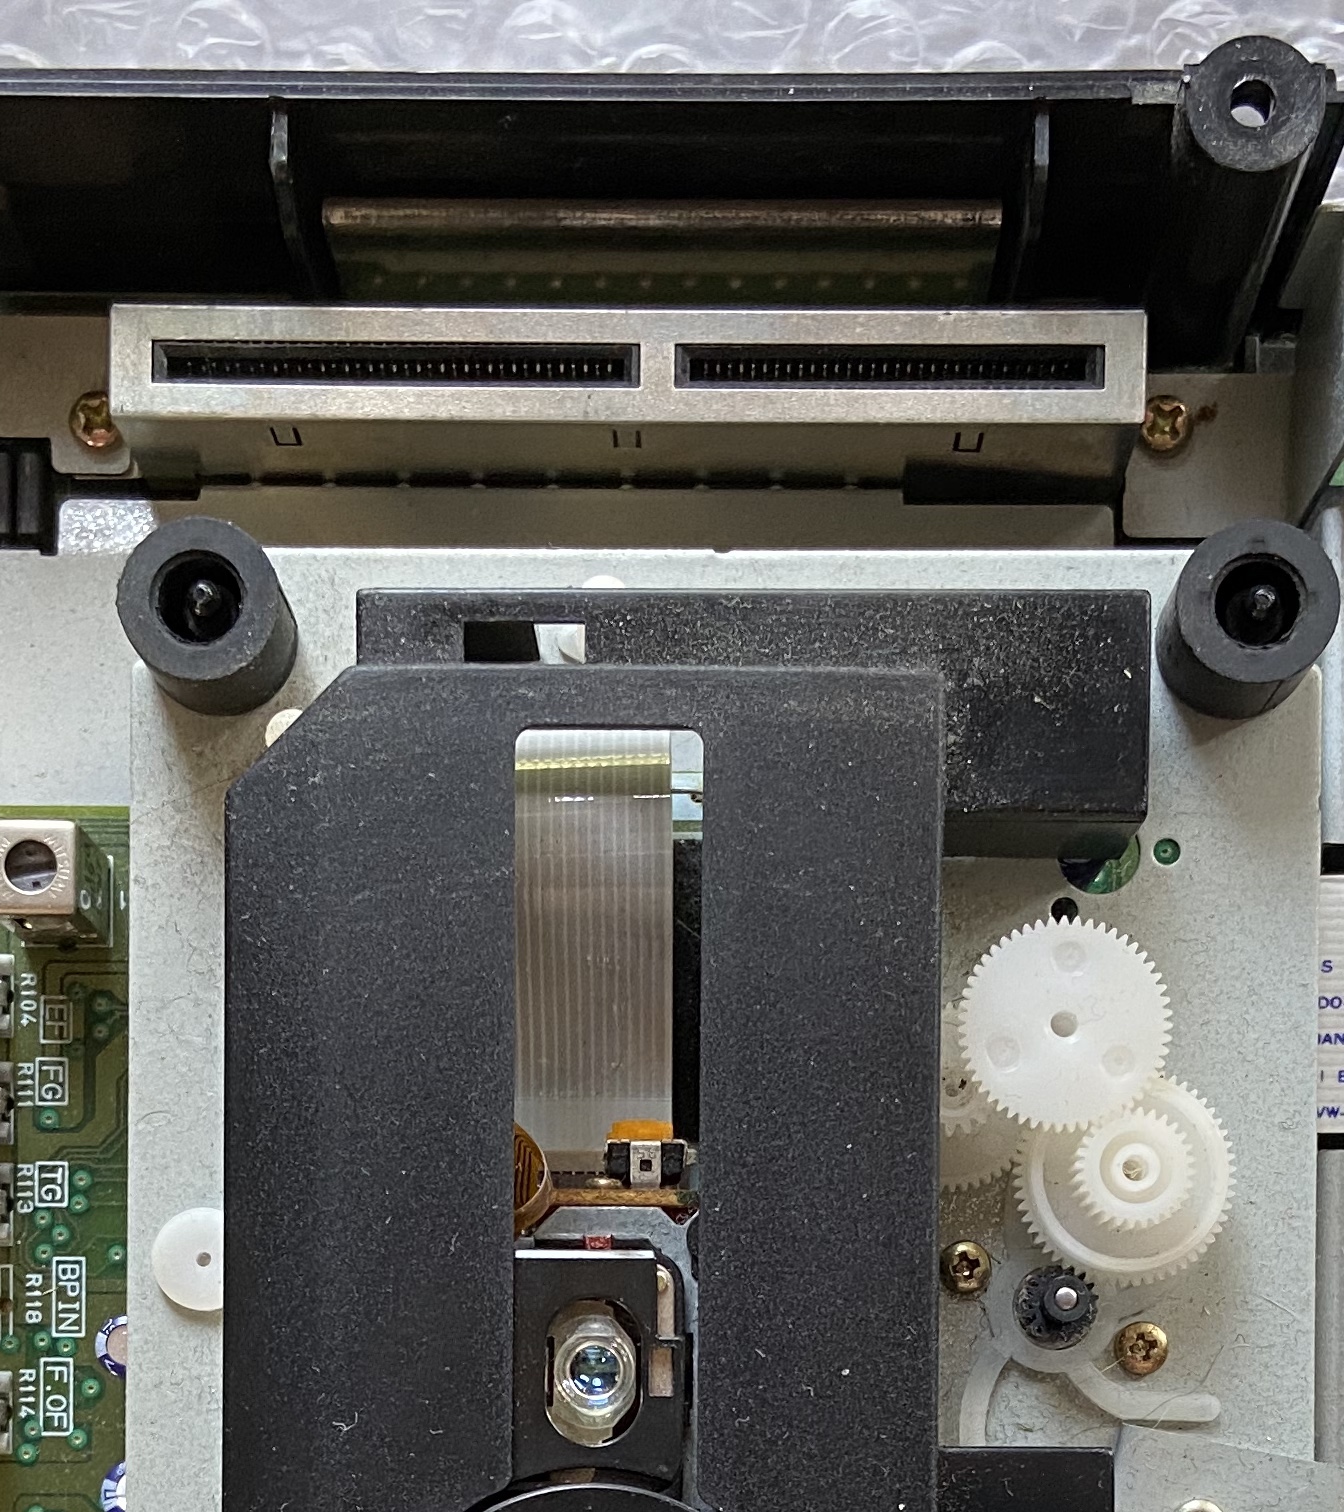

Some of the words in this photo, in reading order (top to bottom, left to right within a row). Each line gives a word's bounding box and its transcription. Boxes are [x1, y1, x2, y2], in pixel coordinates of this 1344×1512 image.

[19, 972, 38, 1028] R104
[45, 1004, 68, 1039] EF
[16, 1061, 35, 1108] R111
[41, 1065, 64, 1101] FG
[16, 1163, 35, 1215] R113
[40, 1165, 64, 1202] TG
[24, 1273, 44, 1325] R118
[18, 1368, 37, 1420] R114
